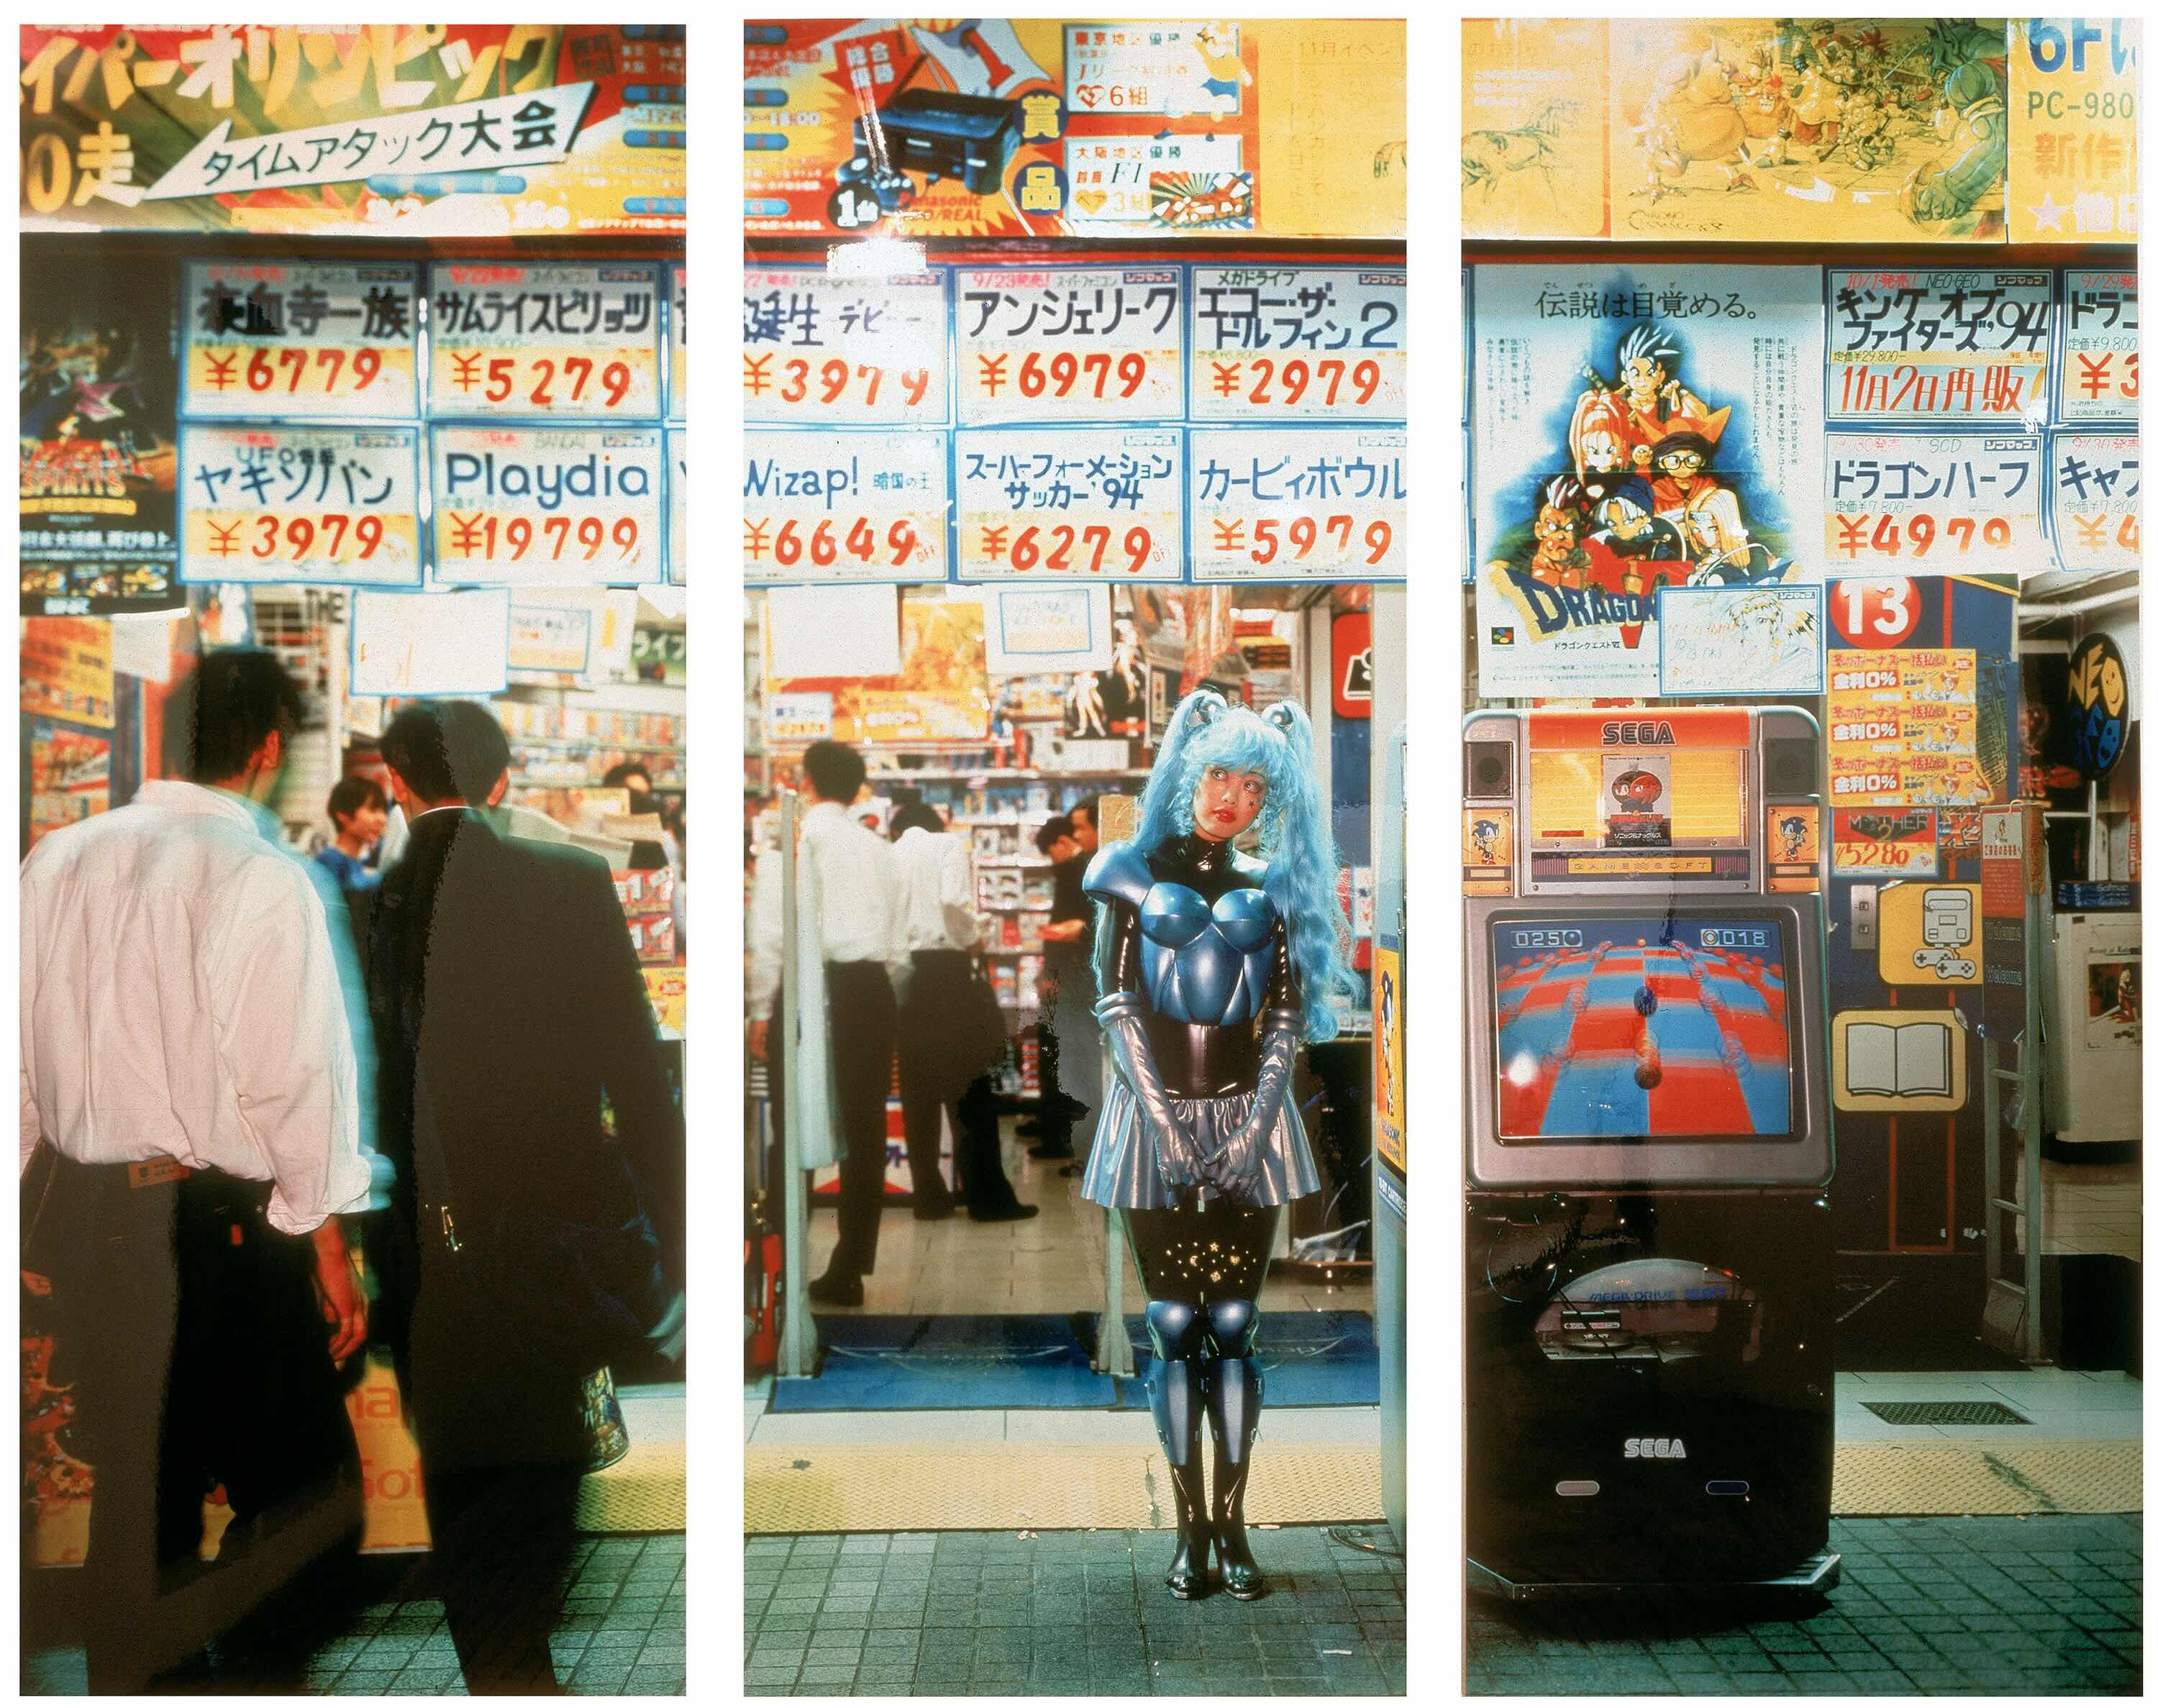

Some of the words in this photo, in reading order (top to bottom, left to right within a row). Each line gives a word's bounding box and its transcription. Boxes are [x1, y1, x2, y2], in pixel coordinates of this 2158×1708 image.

[20, 24, 550, 116] イパーオリンピック
[2028, 91, 2134, 119] PC-980
[20, 120, 152, 214] 0走
[202, 100, 557, 188] タイムアタック大会
[2035, 132, 2136, 179] 新作
[2080, 273, 2138, 289] 9/29発
[965, 288, 1178, 338] アンジェリーク
[1535, 289, 1757, 320] 伝説は目覚める。
[1216, 317, 1352, 350] ドルフィン
[204, 347, 383, 393] ¥6779
[451, 351, 631, 408] ¥5279
[978, 352, 1146, 398] ¥6979
[1211, 359, 1380, 406] ¥2979
[195, 457, 393, 504] ヤキソバン
[447, 452, 650, 511] Playdia
[1199, 455, 1406, 501] カービィボウル
[1833, 460, 2029, 499] ドラゴンハーフ
[207, 515, 384, 560] ¥3979
[450, 511, 639, 562] ¥19799
[744, 516, 916, 567] ¥6649
[981, 524, 1152, 573] ¥6279
[1213, 514, 1393, 565] ¥5979
[1603, 721, 1676, 746] SEGA
[1573, 861, 1630, 871] GAME
[1514, 932, 1560, 947] 025
[1722, 932, 1766, 946] 018
[1624, 1438, 1687, 1458] SEGA
